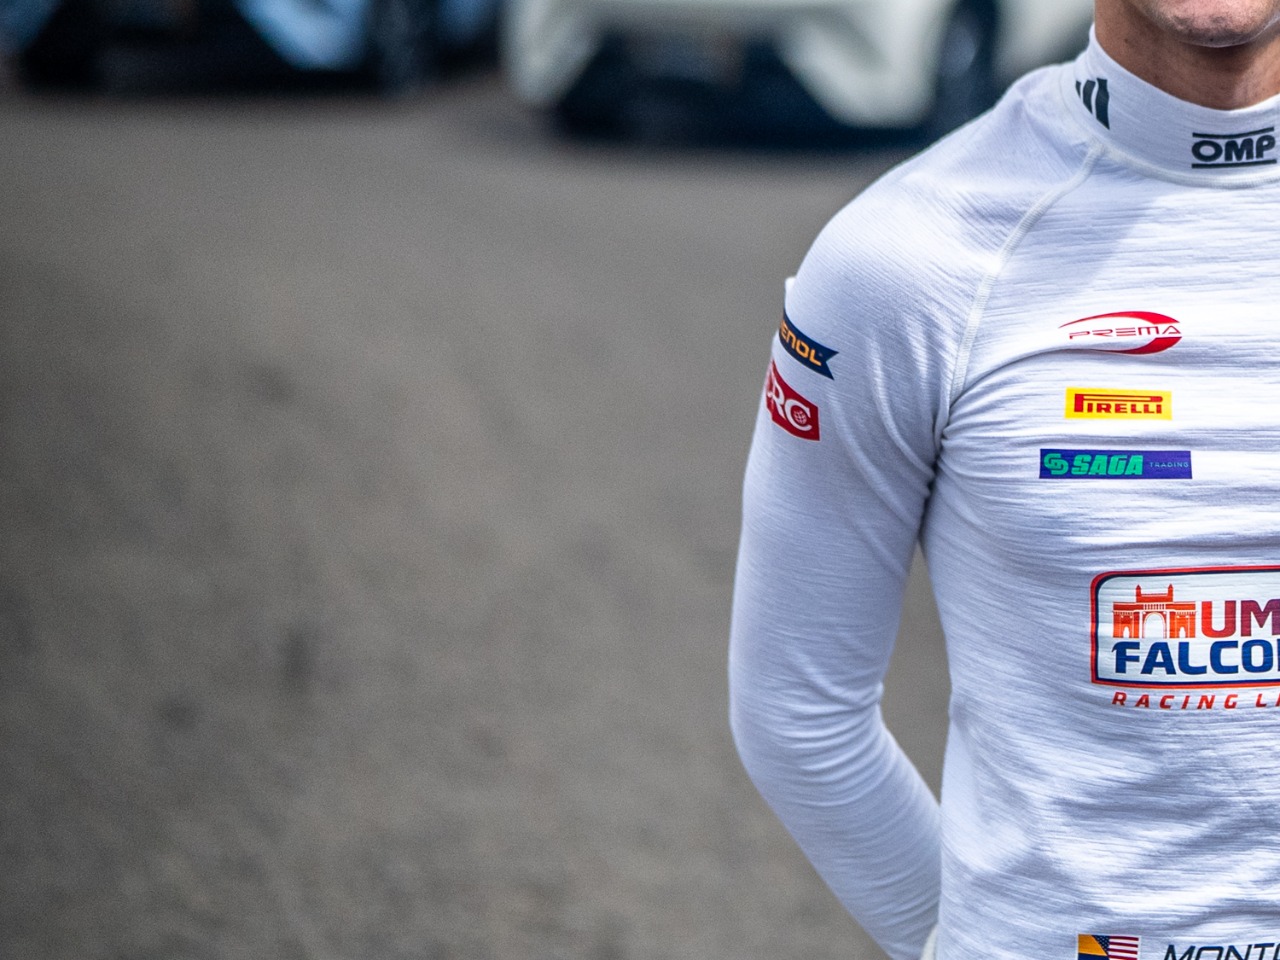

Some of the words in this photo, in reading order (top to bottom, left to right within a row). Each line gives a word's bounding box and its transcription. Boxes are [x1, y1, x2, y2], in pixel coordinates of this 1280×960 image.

[1192, 135, 1276, 162] OMP
[1069, 325, 1181, 339] PREMA
[1074, 393, 1163, 414] PIRELLI
[1071, 454, 1143, 475] SAGA
[1112, 691, 1239, 709] RACING
